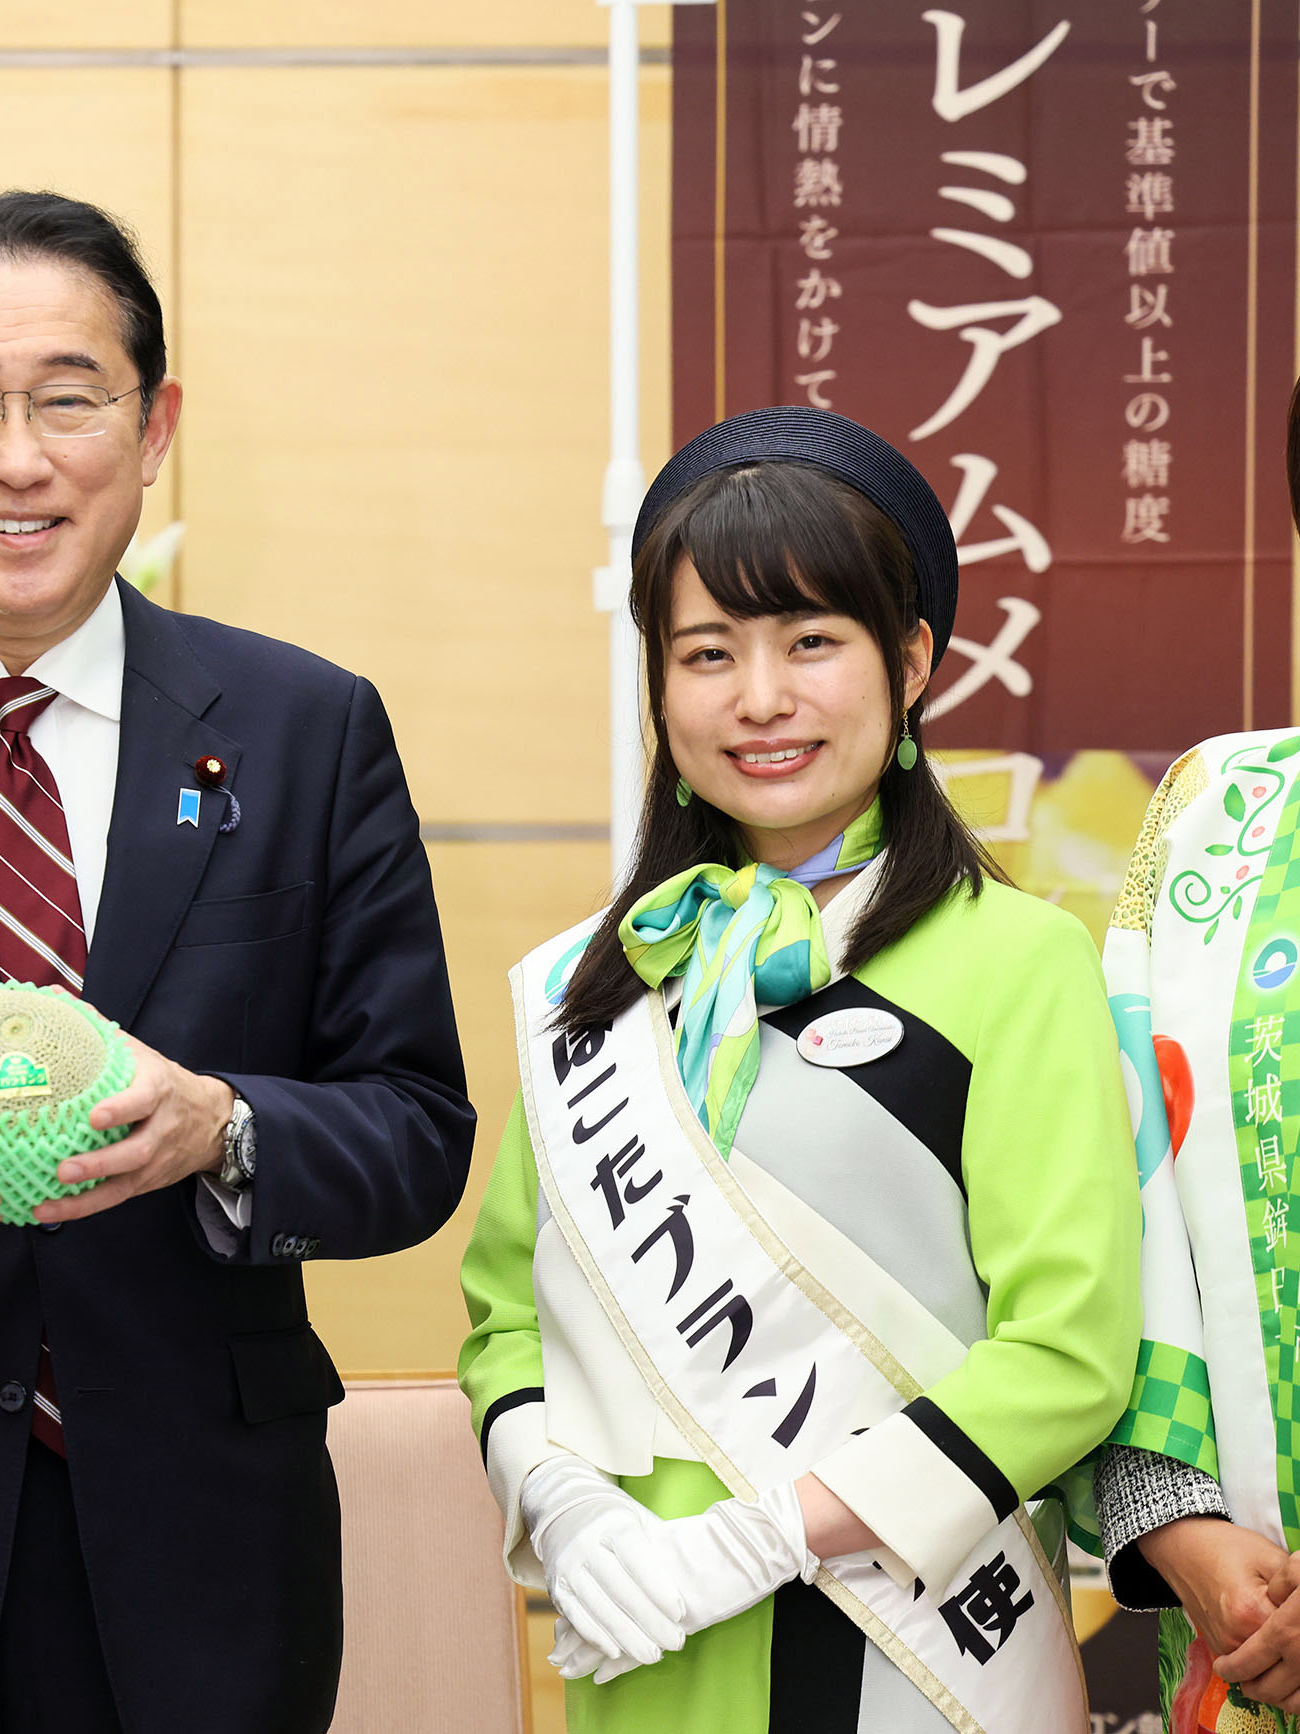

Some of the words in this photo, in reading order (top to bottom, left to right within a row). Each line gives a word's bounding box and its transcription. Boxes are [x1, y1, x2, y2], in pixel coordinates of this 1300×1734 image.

[792, 11, 843, 409] ンに情熱をかけて
[907, 10, 1071, 904] レミアムメロ
[1121, 0, 1177, 544] ーで基準値以上の糖度
